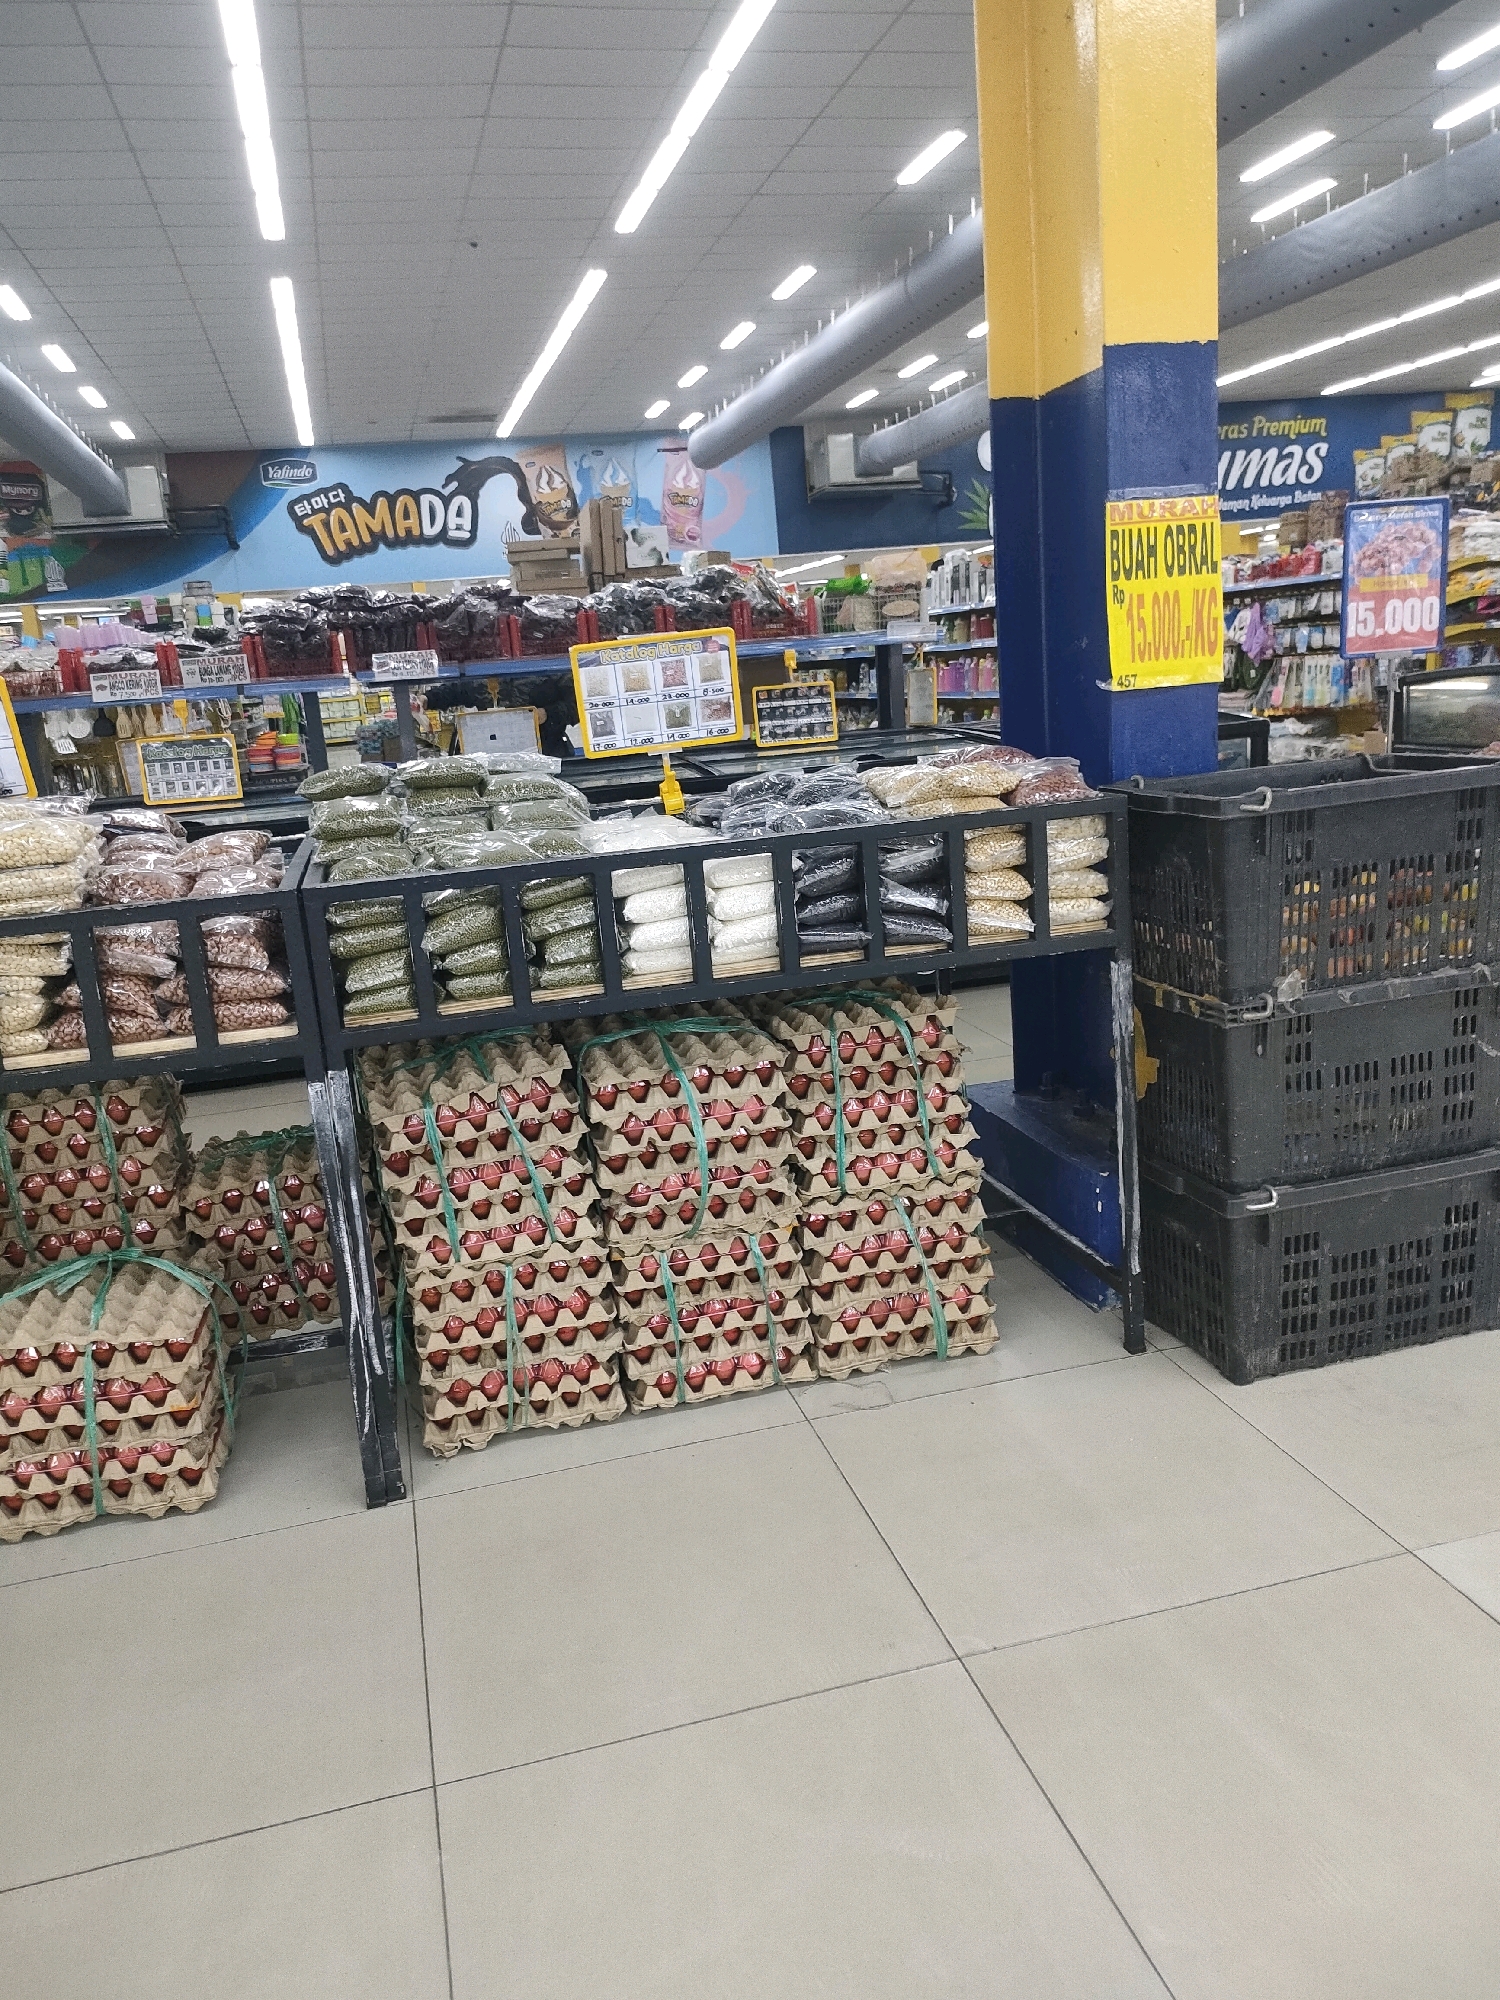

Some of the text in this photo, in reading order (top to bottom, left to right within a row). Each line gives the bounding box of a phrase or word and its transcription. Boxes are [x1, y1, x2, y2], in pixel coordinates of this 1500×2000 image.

[1218, 415, 1327, 440] ras Premium
[268, 464, 313, 479] Yafindo
[293, 488, 346, 516] 타마다
[1110, 495, 1218, 522] MURAH
[302, 493, 474, 557] TAMADA
[1110, 521, 1218, 582] BUAH OBRAL
[1112, 584, 1125, 610] Rp
[197, 655, 244, 666] MURAH
[601, 645, 657, 665] Katalog
[658, 640, 703, 657] Harga
[108, 671, 157, 681] MURAH
[1117, 674, 1138, 689] 457
